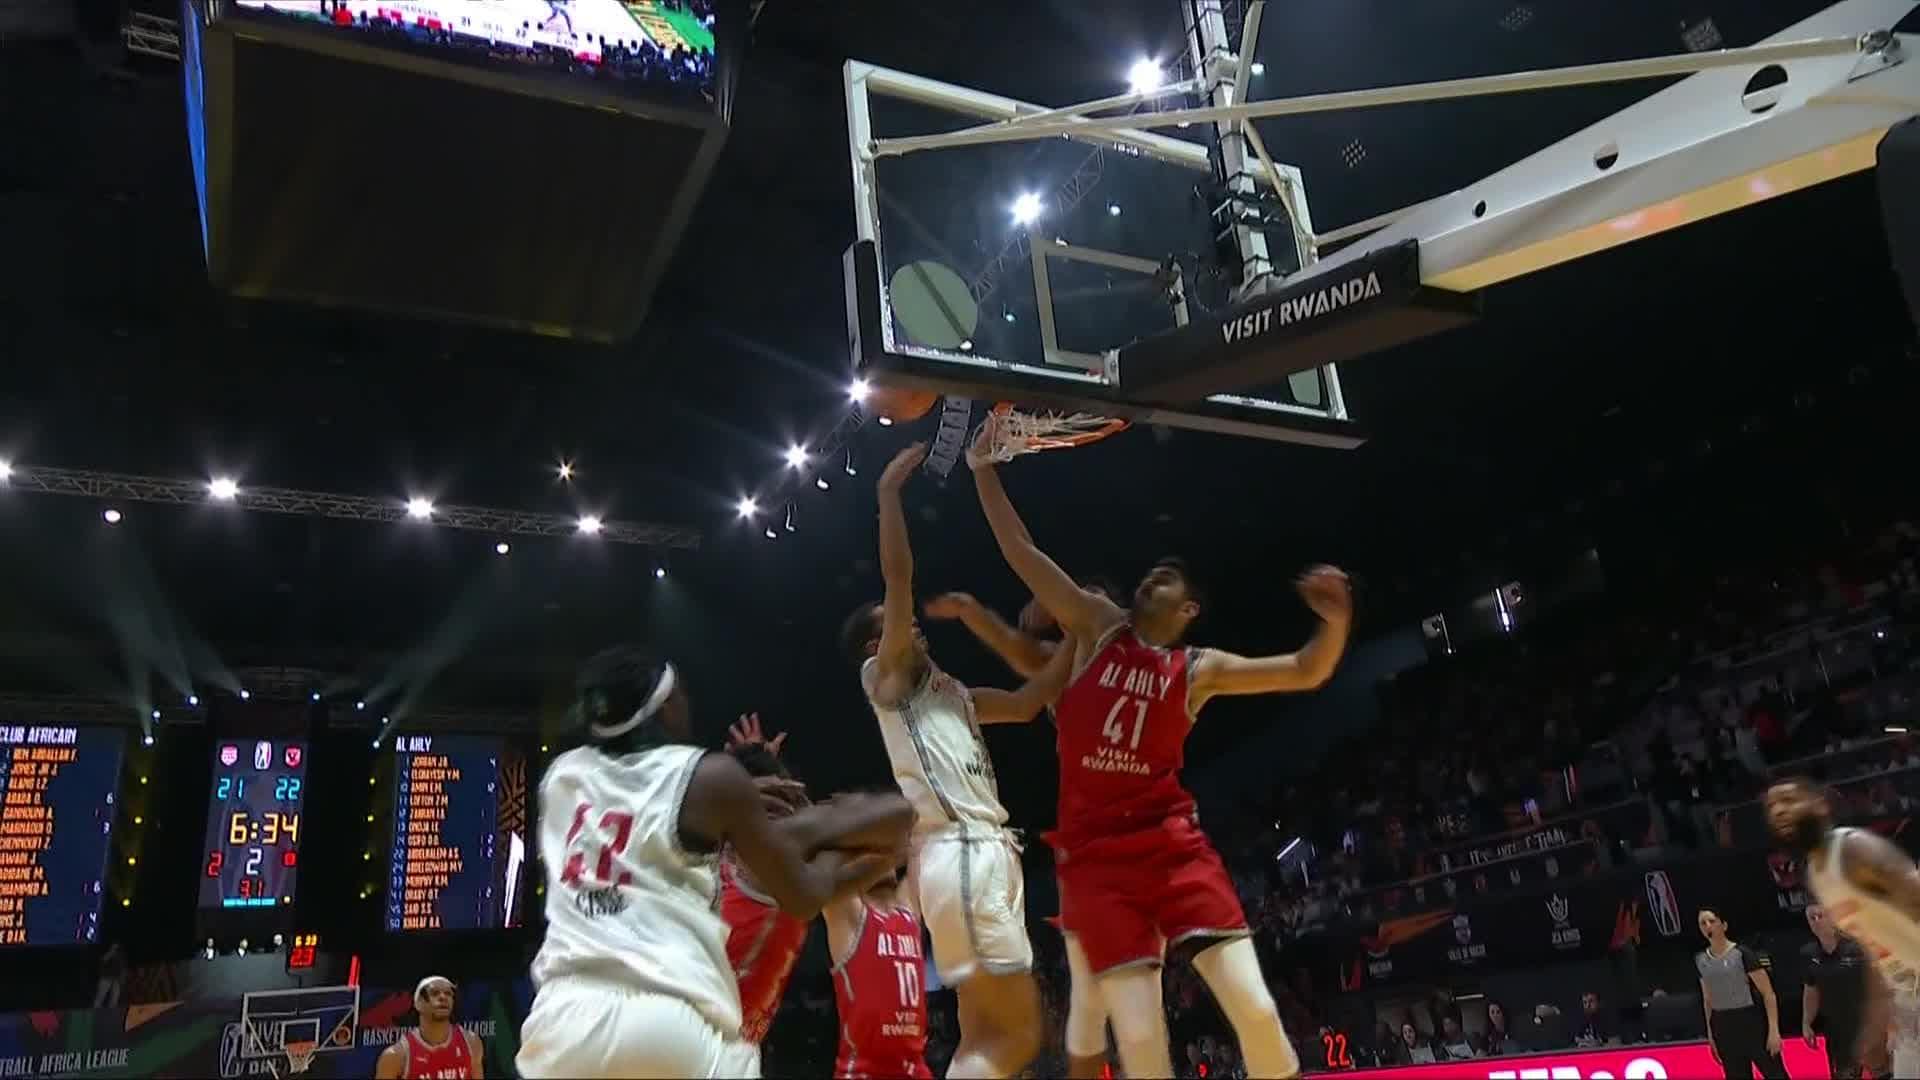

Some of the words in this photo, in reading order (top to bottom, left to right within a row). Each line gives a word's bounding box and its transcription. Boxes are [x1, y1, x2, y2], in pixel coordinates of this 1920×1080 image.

[1222, 308, 1274, 344] VISIT
[1279, 271, 1382, 326] RWANDA
[1098, 661, 1122, 688] AL
[1123, 667, 1171, 701] AHLY
[0, 726, 25, 744] CLUB
[27, 727, 77, 744] AFRICAIN
[1102, 695, 1149, 751] 41
[396, 736, 406, 752] AL
[409, 736, 432, 752] AHLY
[1081, 755, 1151, 775] RWANDA
[217, 778, 244, 800] 21
[275, 778, 300, 800] 22
[230, 812, 299, 844] 6:34
[207, 853, 223, 876] 2
[245, 848, 262, 875] 2
[877, 932, 896, 957] AL
[894, 961, 920, 1008] 10
[39, 1053, 81, 1073] AFRICA
[86, 1048, 129, 1069] LEAGUE
[1323, 1034, 1350, 1066] 22
